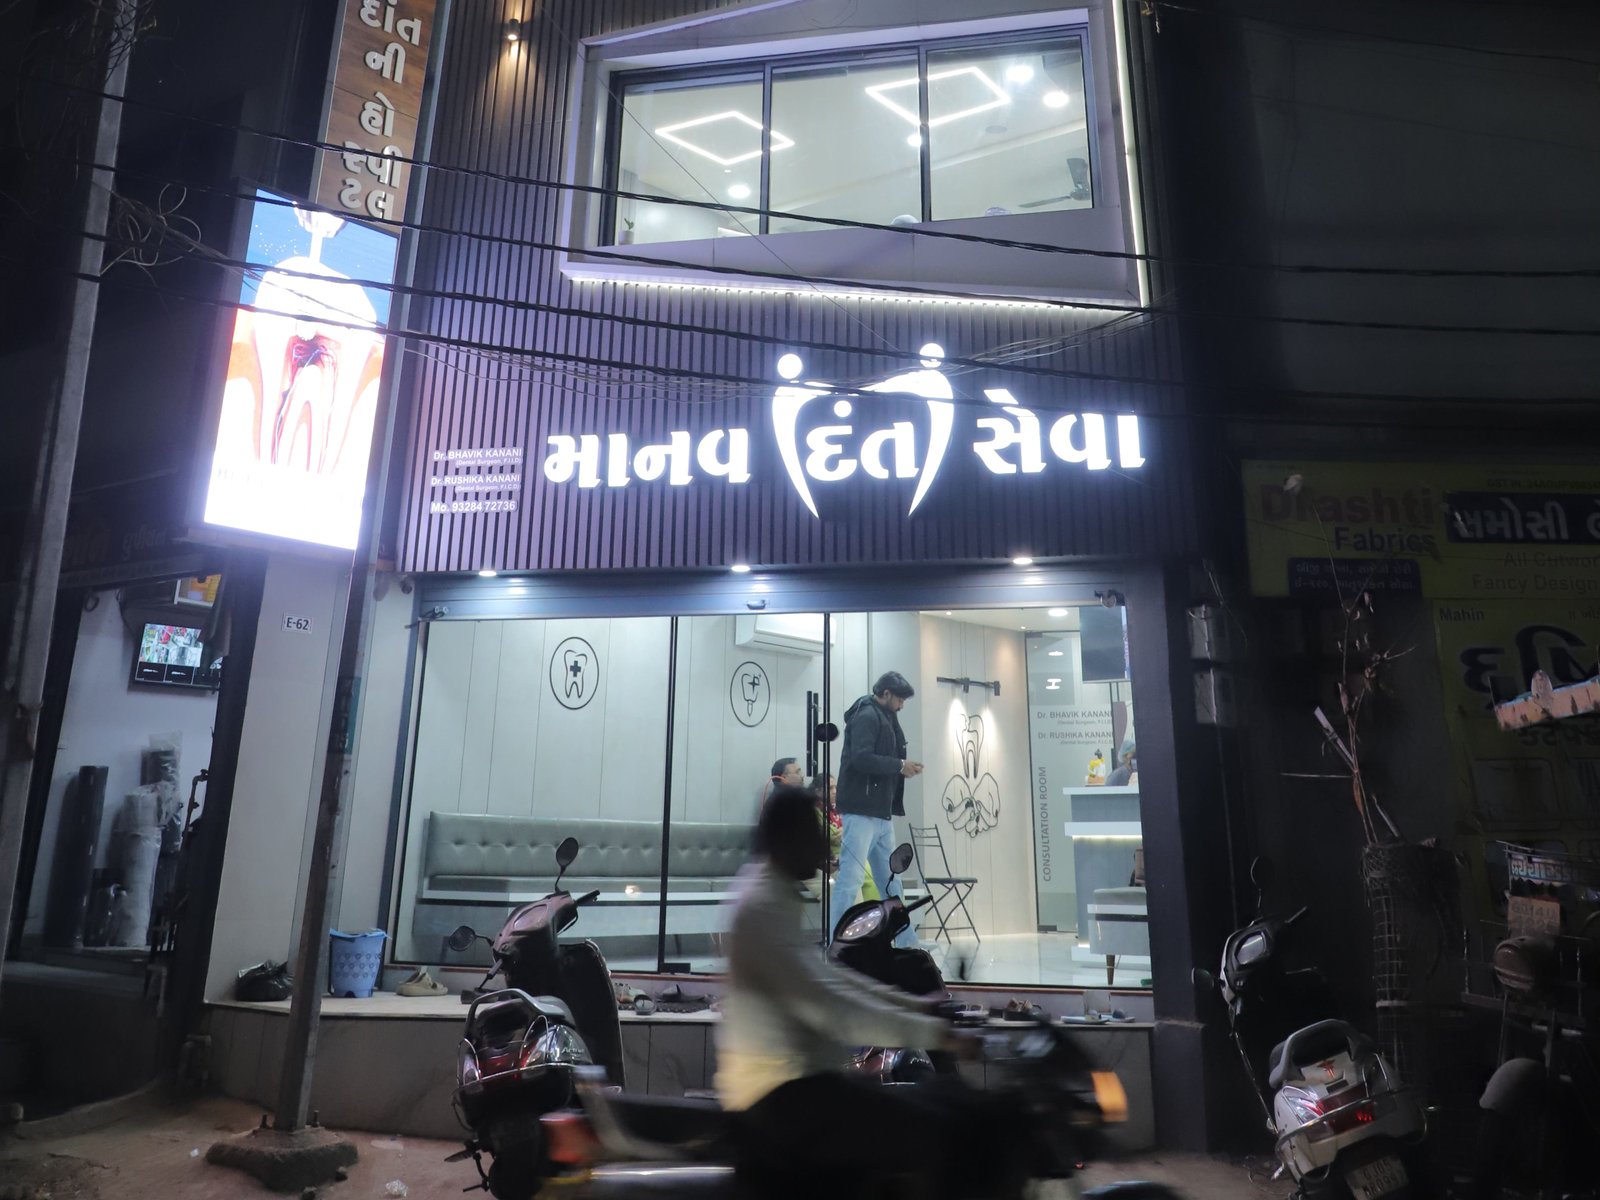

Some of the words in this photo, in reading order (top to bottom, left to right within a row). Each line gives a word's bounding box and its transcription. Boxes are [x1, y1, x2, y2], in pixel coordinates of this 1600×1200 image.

[544, 428, 751, 488] માનવ
[805, 400, 920, 482] દંત
[973, 388, 1146, 474] સેવા
[433, 451, 446, 460] Dr.
[448, 450, 482, 459] BHAVIK
[485, 448, 522, 458] KANANI
[431, 477, 443, 485] Dr.
[444, 476, 484, 485] RUSHIKA
[486, 474, 520, 483] KANANI
[430, 502, 449, 512] Mo.
[452, 501, 482, 512] 93284
[484, 500, 516, 511] 72736
[1334, 527, 1437, 552] Fabrics
[1472, 574, 1528, 592] Fancy
[1440, 607, 1485, 622] Mahin
[286, 616, 309, 630] E-62
[1037, 711, 1047, 719] Dr.
[1049, 710, 1079, 719] BHAVIK
[1049, 731, 1083, 739] RUSHIKA
[1039, 767, 1047, 800] ROOM
[1041, 803, 1051, 882] CONSULTATION
